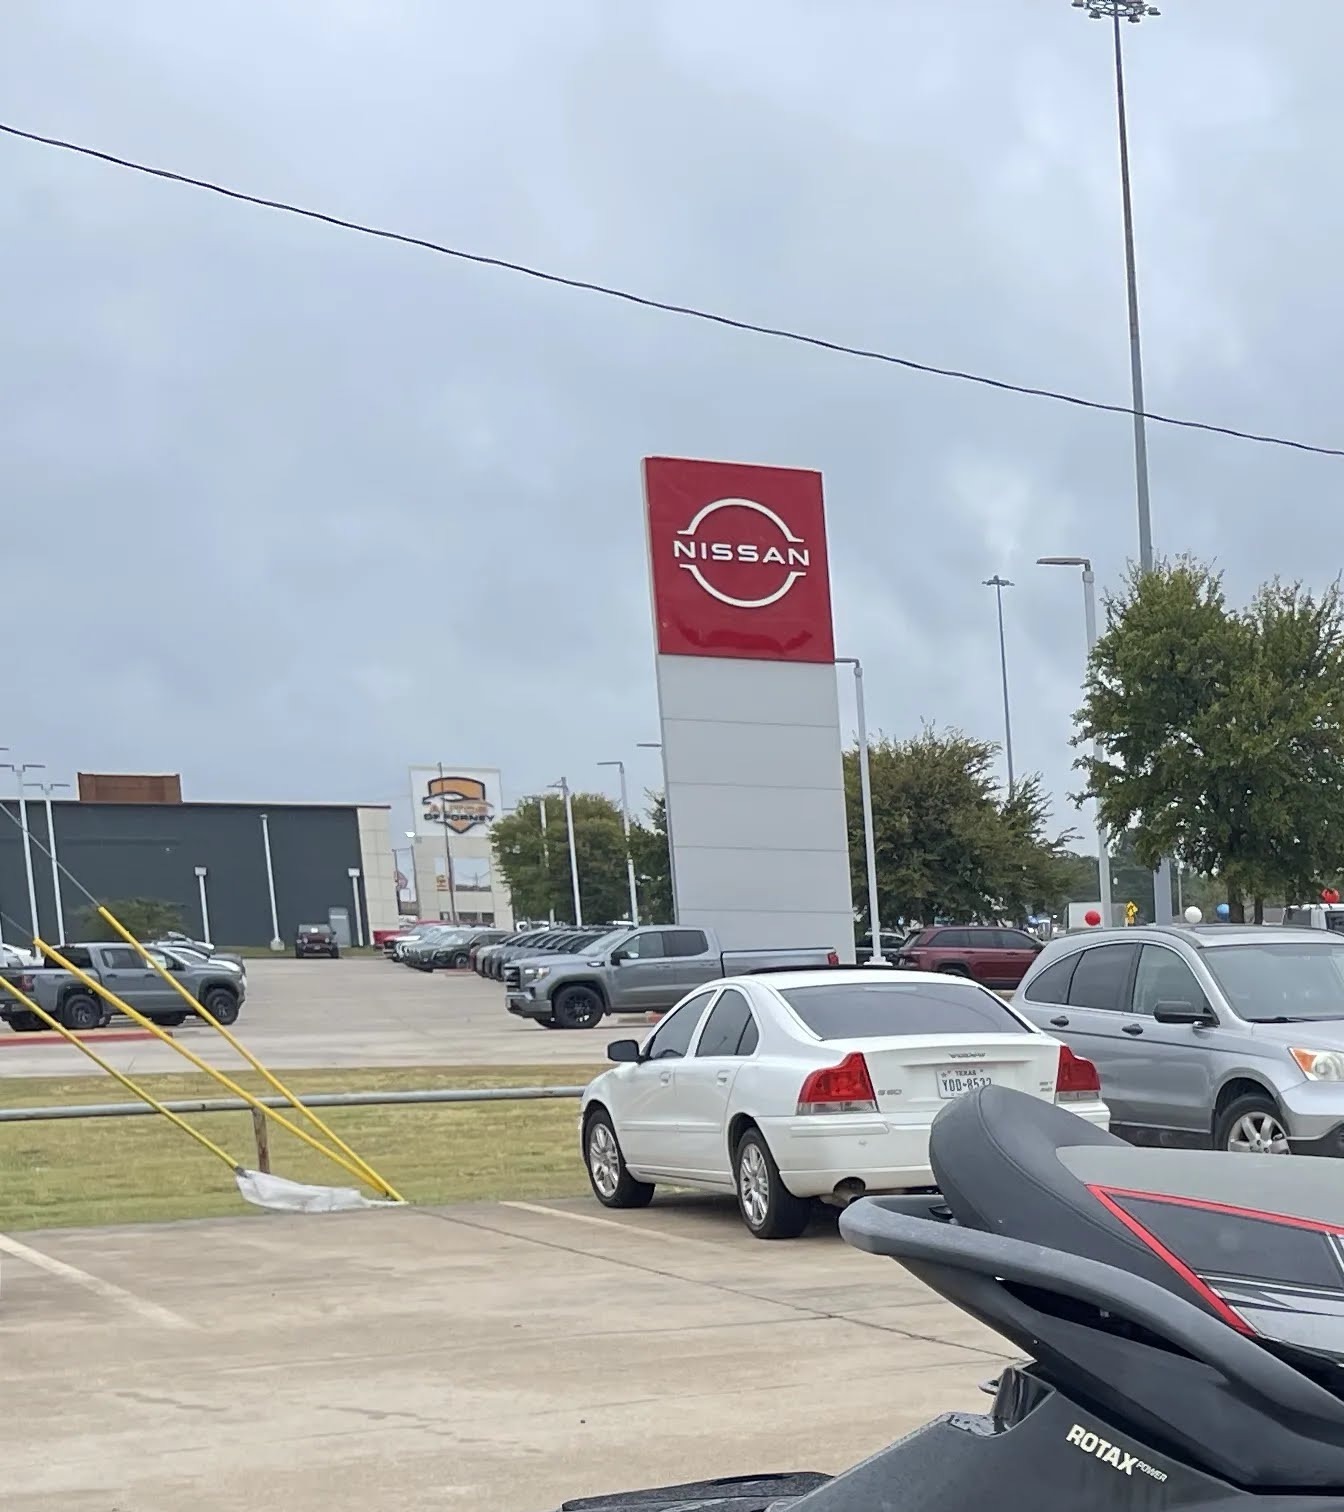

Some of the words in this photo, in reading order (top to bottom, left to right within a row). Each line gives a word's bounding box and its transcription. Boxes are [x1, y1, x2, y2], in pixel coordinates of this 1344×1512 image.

[673, 540, 810, 567] NISSAN
[1065, 1423, 1139, 1476] ROTAX
[1135, 1460, 1168, 1482] POWER
